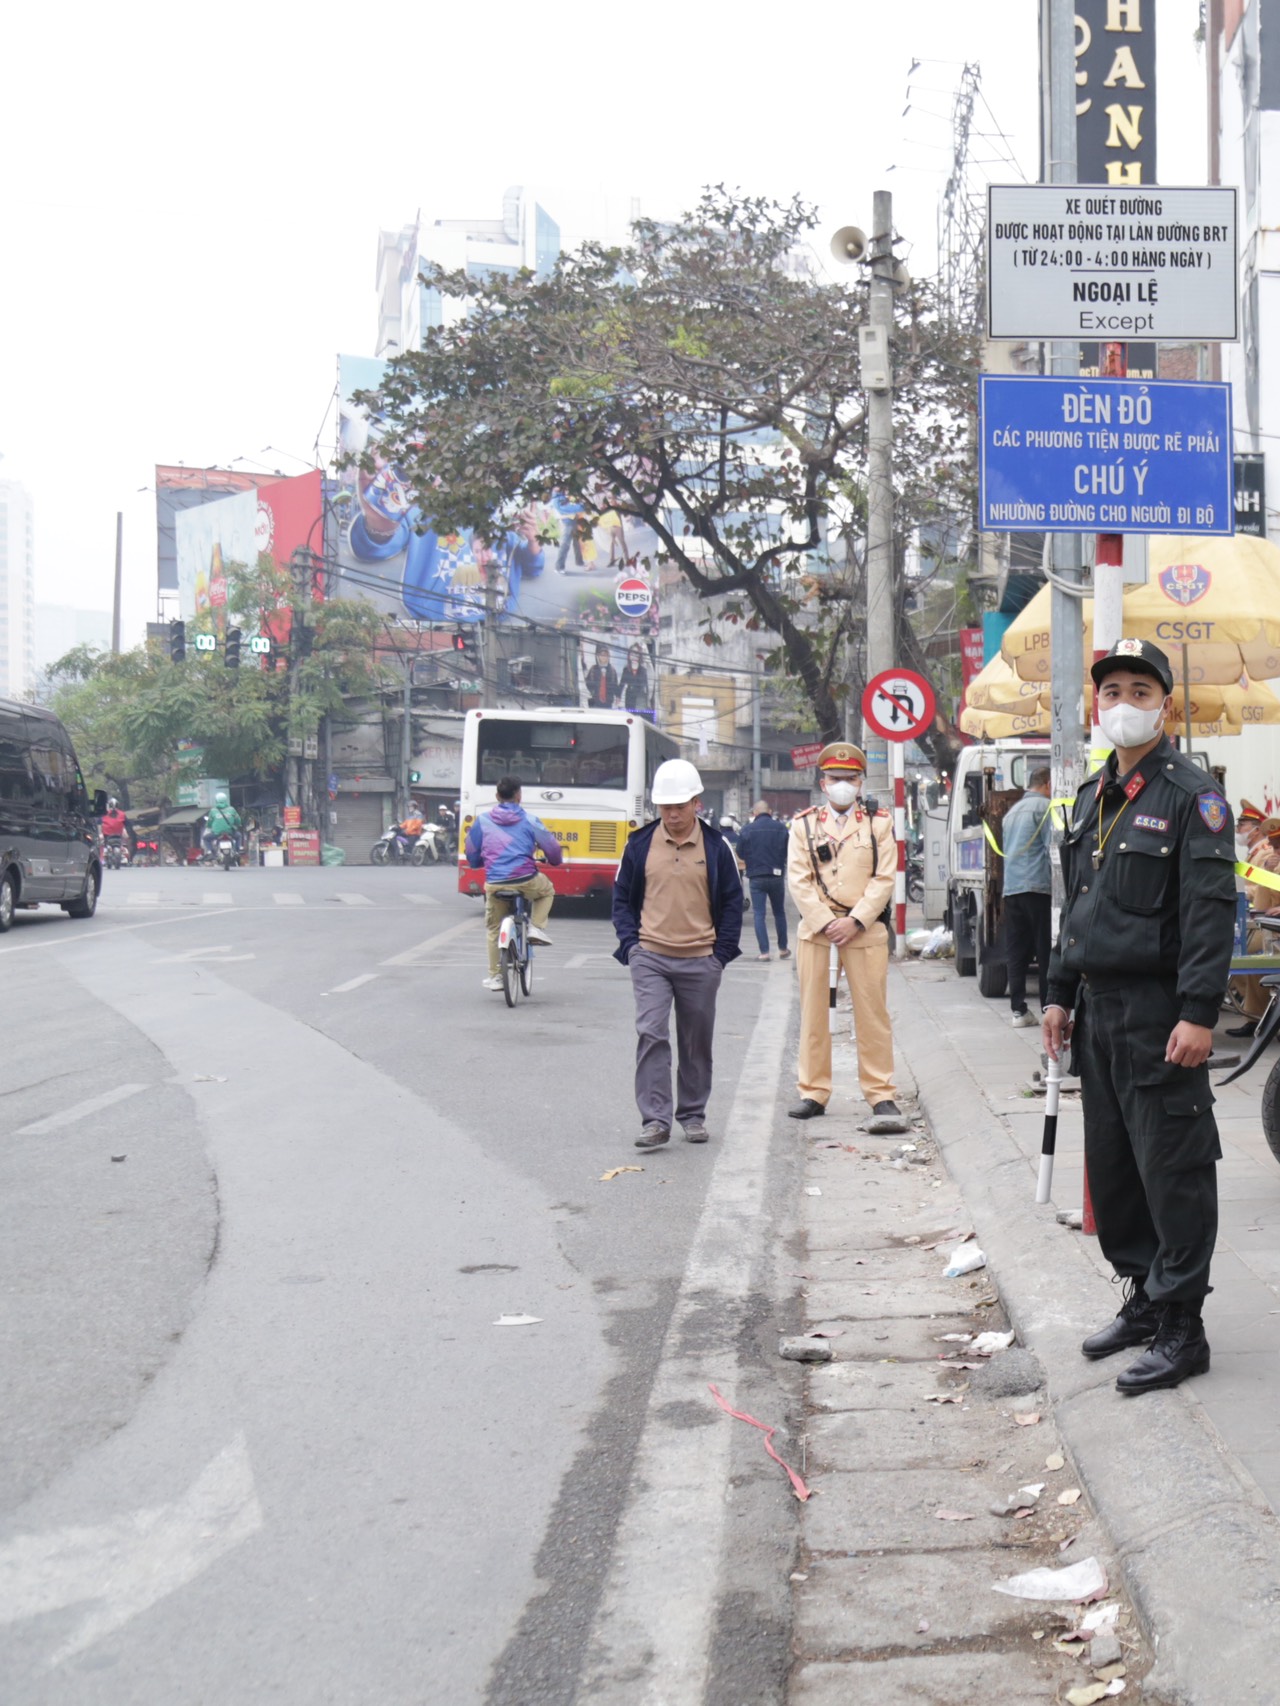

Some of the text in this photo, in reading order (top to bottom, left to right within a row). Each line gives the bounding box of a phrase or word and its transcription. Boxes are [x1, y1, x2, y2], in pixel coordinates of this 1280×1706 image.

[1066, 195, 1162, 216] XE QUÉT ĐƯỜNG
[995, 221, 1228, 244] ĐƯỢC HOẠT ĐỘNG TẠI LÀN ĐƯỜNG BRT
[1022, 247, 1039, 267] TỪ
[1040, 250, 1083, 267] 24:00
[1095, 250, 1129, 267] 4:00
[1132, 248, 1166, 268] HÀNG
[1170, 248, 1203, 268] NGÀY
[1073, 278, 1158, 306] NGOẠI LỆ
[1079, 311, 1154, 334] Except
[1062, 386, 1152, 425] ĐÈN ĐỎ
[993, 425, 1220, 454] CÁC PHƯƠNG TIỆN ĐƯỢC RẼ PHẢI
[1074, 457, 1149, 496] CHÚ Ý
[990, 498, 1214, 528] NHƯỜNG ĐƯỜNG CHO NGƯỜI ĐI BỘ
[617, 592, 650, 603] PEPSI
[1156, 621, 1215, 640] CSGT
[1024, 632, 1050, 652] LPB
[1012, 712, 1044, 731] CSGT
[1241, 705, 1265, 722] CSGT
[1135, 816, 1166, 830] C.S.C.D
